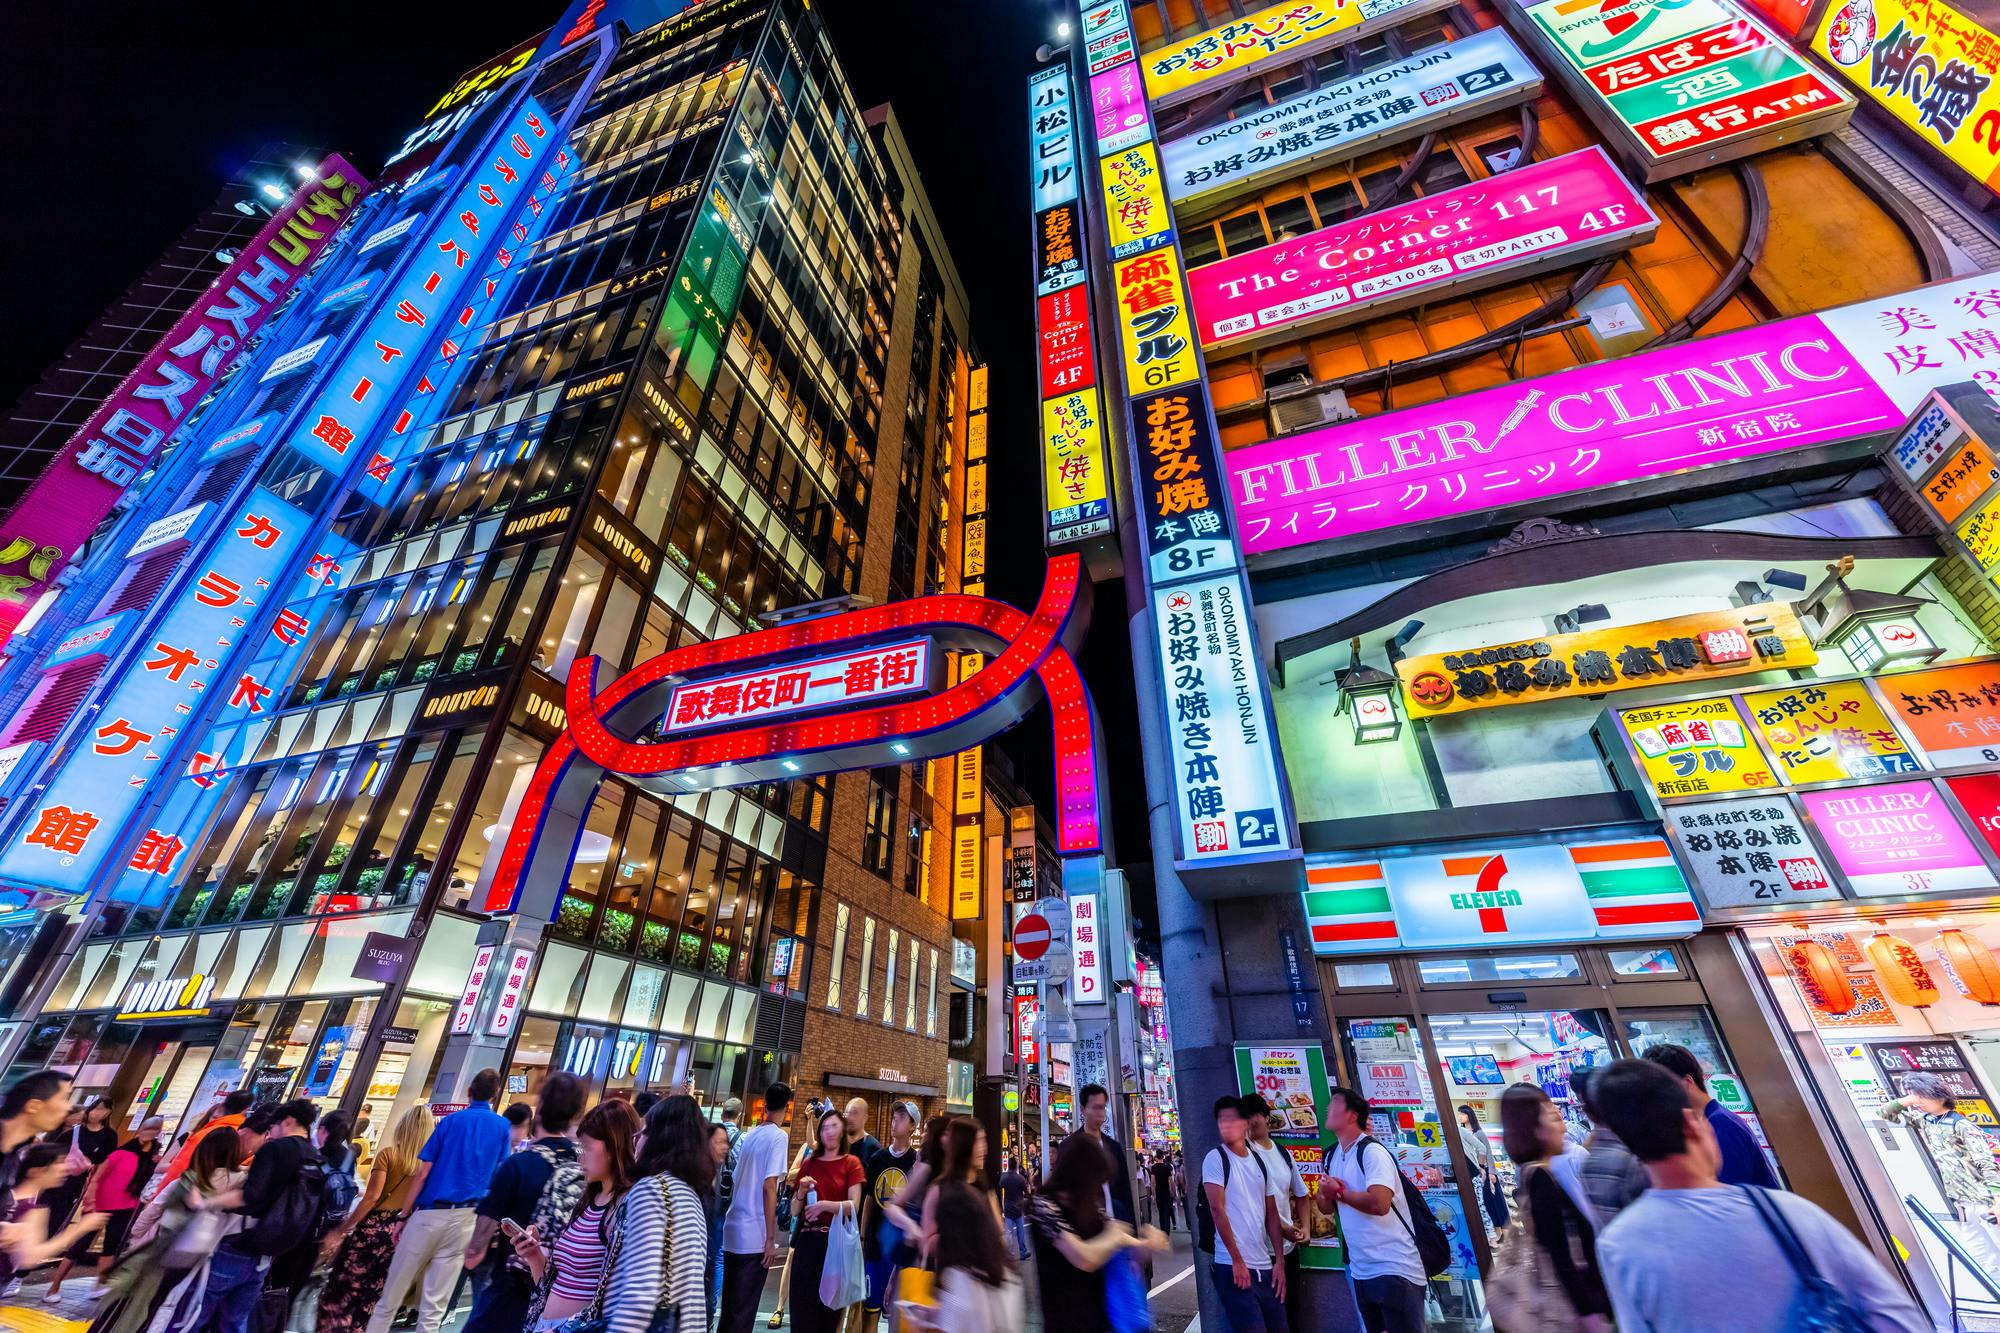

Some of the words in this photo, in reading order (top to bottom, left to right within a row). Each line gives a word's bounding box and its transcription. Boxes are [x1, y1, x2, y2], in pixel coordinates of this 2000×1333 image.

[1188, 3, 1315, 73] もんじゃ
[1262, 10, 1338, 53] たこ
[1152, 21, 1256, 76] お好み
[1598, 29, 1757, 90] たばこ
[1117, 66, 1135, 105] フィラー
[1463, 69, 1514, 92] 2F
[1661, 66, 1744, 106] 酒
[1870, 19, 1993, 145] 金の蔵
[1096, 86, 1117, 137] クリニック
[1196, 86, 1354, 147] OKONOMIYAKI
[1357, 52, 1452, 90] HONJIN
[1278, 88, 1392, 134] 歌舞伎町名物
[1649, 88, 1827, 147] 銀行ATM
[1035, 87, 1072, 190] 小松ビル
[1184, 95, 1420, 187] お好み焼き本陣
[1110, 161, 1146, 193] もんじゃ
[1125, 150, 1153, 178] お好み
[1107, 183, 1131, 203] たこ
[1119, 196, 1153, 235] 焼き
[1273, 193, 1490, 265] ダイニングレストラン
[1577, 203, 1627, 234] 4F
[1044, 206, 1075, 266] お好み焼
[1146, 232, 1166, 247] 7F
[1219, 266, 1300, 300] The
[1317, 216, 1473, 270] Corner
[1489, 185, 1561, 222] 117
[1459, 229, 1559, 266] 貸切PARTY
[1043, 260, 1079, 277] 本陣
[1048, 274, 1075, 290] 8F
[1119, 253, 1176, 314] 麻雀
[1359, 263, 1446, 294] 最大100名
[1264, 291, 1347, 319] 宴会ホール
[1043, 322, 1084, 341] Corner
[1129, 304, 1187, 365] ブル
[1218, 316, 1249, 333] 個室
[1051, 333, 1077, 348] 117
[566, 372, 625, 400] DOUTOR
[1052, 366, 1083, 387] 4F
[1144, 360, 1181, 386] 6F
[643, 380, 692, 441] DOUTOR
[1067, 395, 1095, 430] お好み
[1233, 417, 1493, 507] FILLER
[1547, 338, 1850, 434] CLINIC
[1053, 404, 1086, 449] もんじゃ
[1696, 411, 1803, 448] 新宿院
[1050, 432, 1072, 458] たこ
[1145, 396, 1211, 517] お好み焼
[1058, 454, 1091, 500] 焼き
[1930, 450, 1982, 502] お好み焼
[1084, 502, 1102, 516] 7F
[1245, 498, 1383, 542] フィラー
[1396, 445, 1602, 515] クリニック
[505, 506, 571, 536] DOUTOR
[1054, 505, 1075, 518] 本陣
[1154, 510, 1221, 541] 本陣
[593, 515, 651, 575] DOUTOR
[1057, 522, 1101, 540] 小松ビル
[1964, 512, 1987, 547] お好み
[1971, 510, 2000, 556] もんじゃ
[1168, 547, 1216, 572] 8F
[1198, 590, 1222, 656] 歌舞伎町名物
[1217, 586, 1247, 683] OKONOMIYAKI
[1235, 684, 1258, 744] HONJIN
[25, 511, 283, 857] カラオケ館
[676, 651, 918, 725] 歌舞伎町一番街
[424, 685, 500, 718] DOUTOR
[1167, 612, 1226, 820] お好み焼き本陣
[1626, 702, 1729, 725] 全国チェーンの店
[1757, 687, 1828, 727] お好み
[1660, 720, 1715, 747] 麻雀
[1768, 698, 1861, 746] もんじゃ
[1779, 737, 1832, 769] たこ
[1832, 727, 1903, 756] 焼き
[1667, 749, 1735, 777] ブル
[1884, 756, 1914, 773] 7F
[1657, 778, 1710, 796] 新宿店
[1742, 771, 1769, 788] 6F
[970, 816, 977, 826] 3
[1680, 807, 1785, 828] 歌舞伎町名物
[1823, 793, 1920, 818] FILLER
[1239, 815, 1276, 842] 2F
[1685, 824, 1802, 853] お好み焼
[1834, 813, 1935, 841] CLINIC
[1717, 851, 1779, 876] 本陣
[1749, 878, 1783, 900] 2F
[1902, 872, 1933, 892] 3F
[367, 949, 403, 963] SUZUYA
[1075, 902, 1097, 993] 劇場通り
[121, 973, 217, 1014] DOUTOR
[458, 953, 491, 1026] 劇場通り
[497, 955, 528, 1028] 劇場通り
[1017, 986, 1035, 996] 焼肉
[1295, 1001, 1307, 1012] 17
[1371, 1065, 1404, 1078] ATM
[1877, 1048, 1903, 1069] 8F
[879, 1068, 900, 1082] SUZUYA
[1255, 1074, 1279, 1091] 30
[1710, 1079, 1742, 1102] 酒
